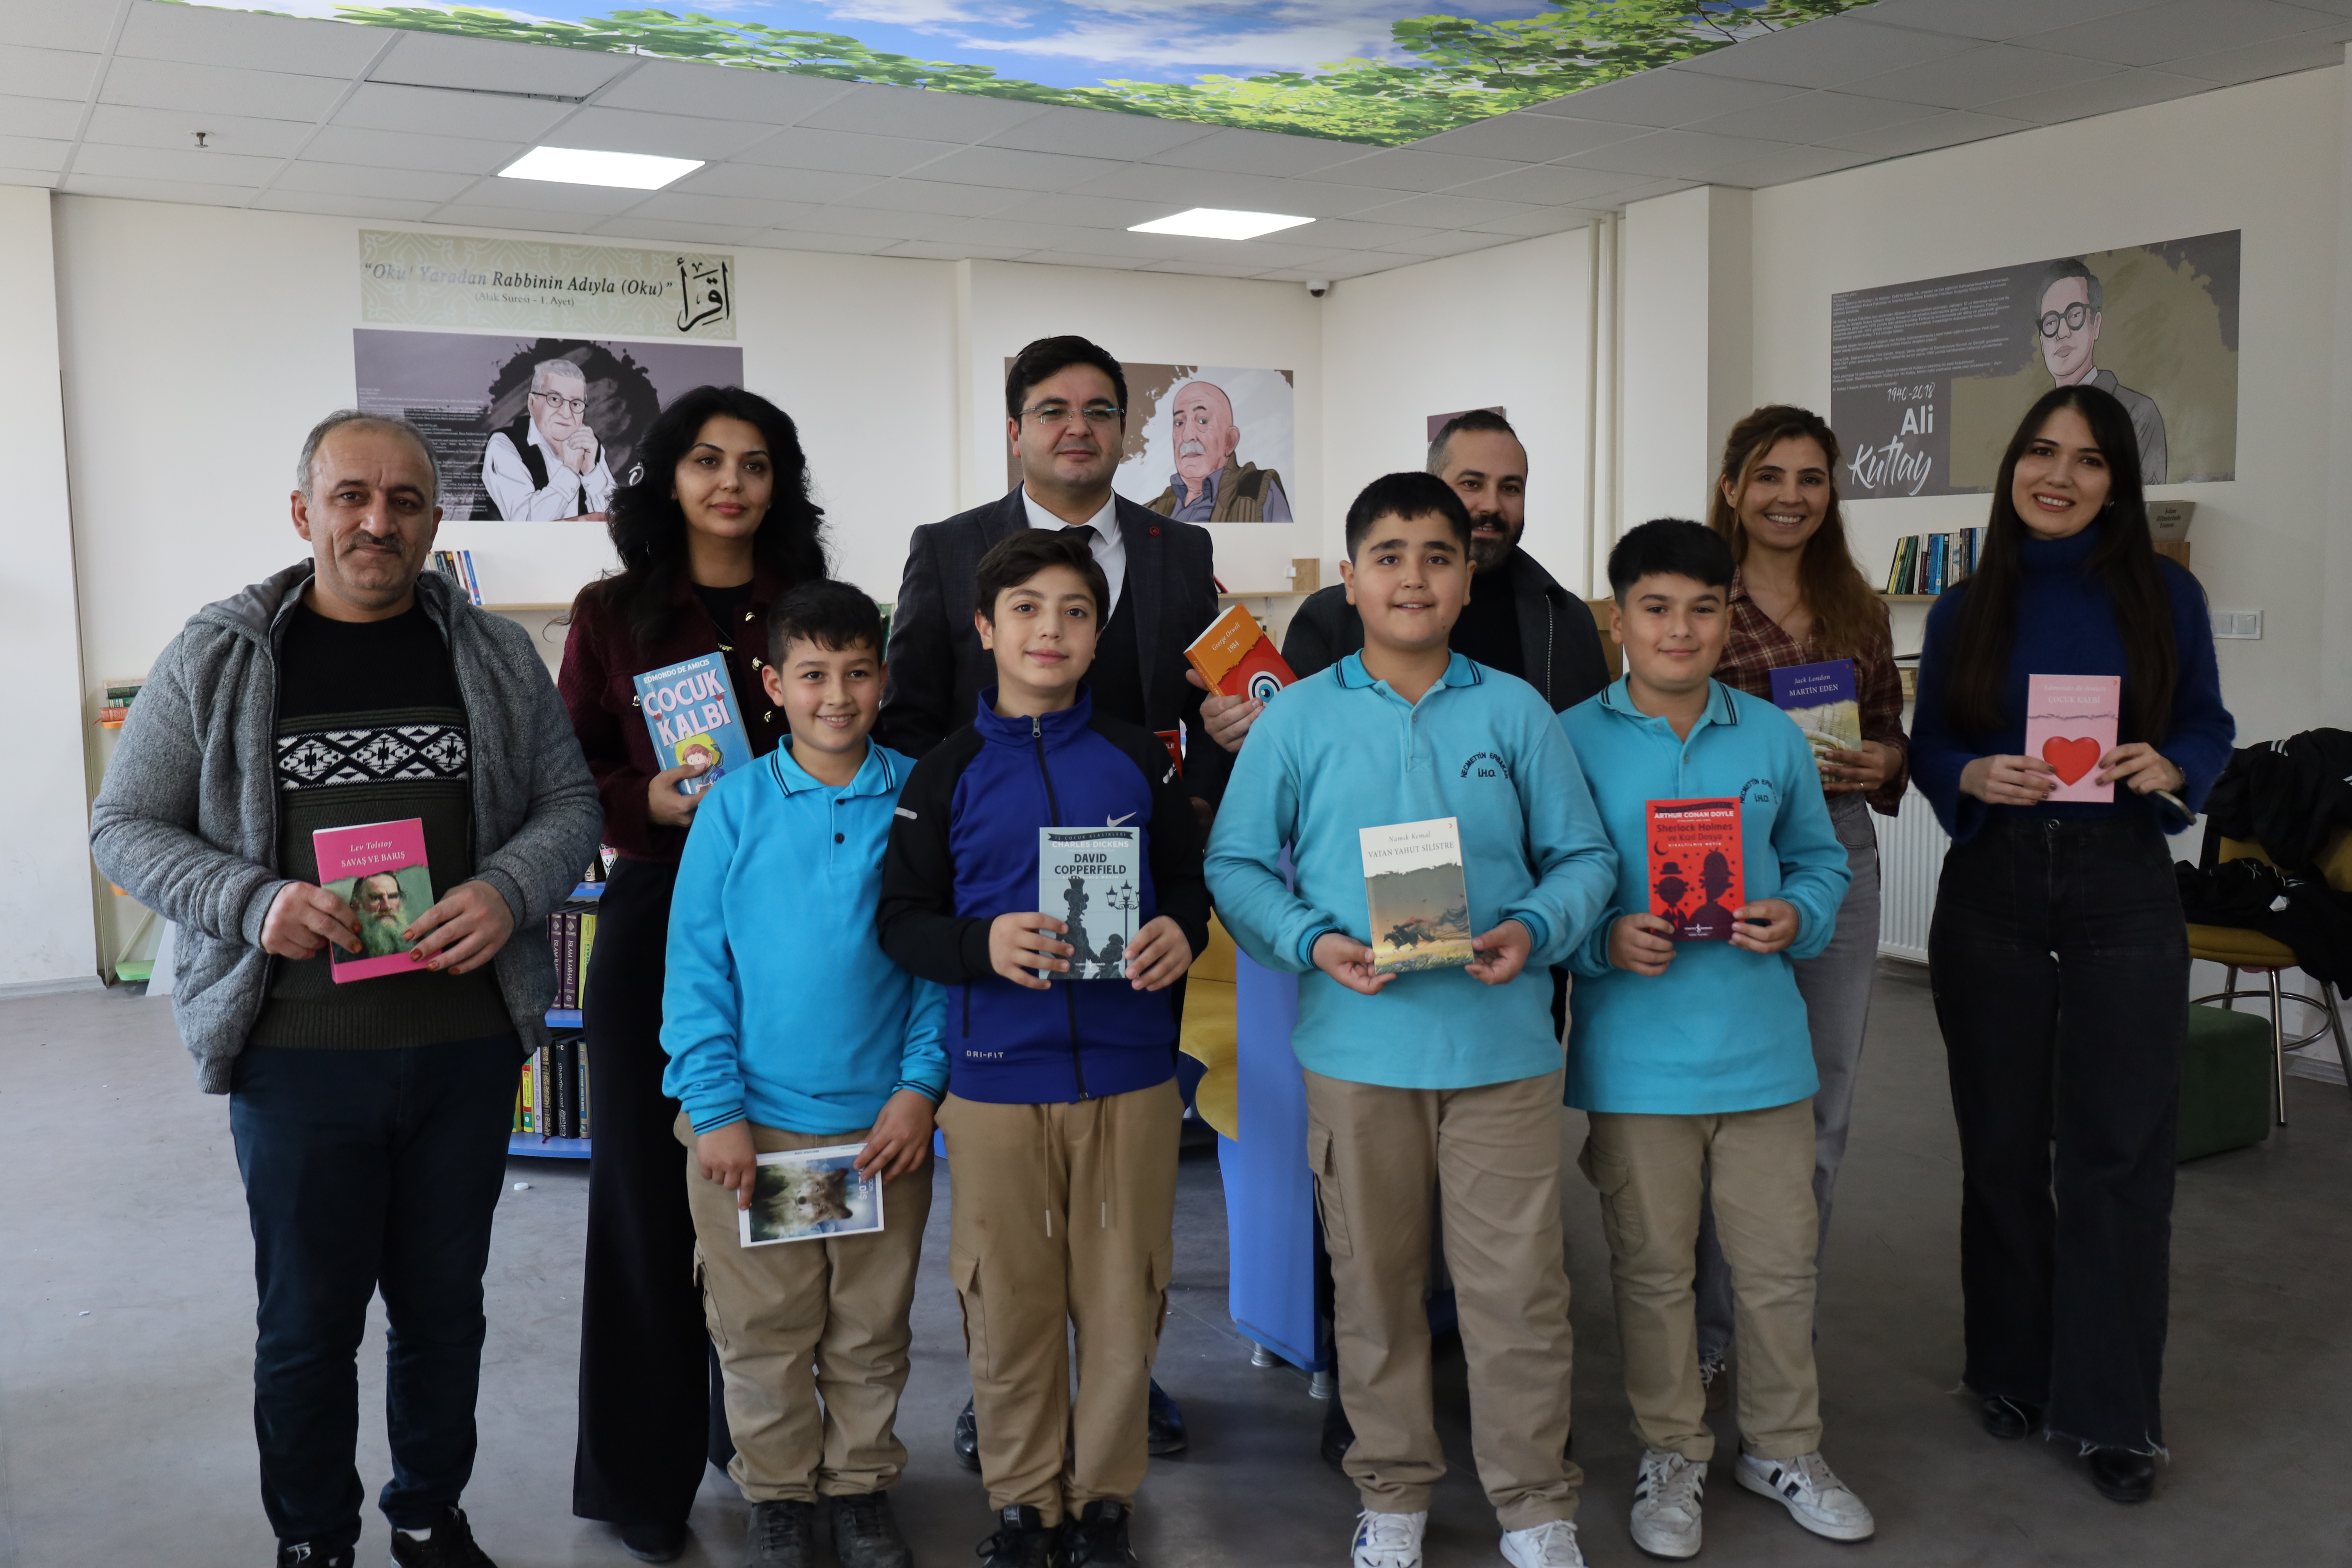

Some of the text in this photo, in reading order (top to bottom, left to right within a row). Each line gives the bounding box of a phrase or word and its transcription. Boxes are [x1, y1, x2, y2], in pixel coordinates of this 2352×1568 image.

[420, 266, 487, 285] Yaradan
[492, 271, 562, 290] Rabbinin
[567, 276, 614, 296] Adıyla
[502, 294, 529, 303] Suresi
[550, 297, 574, 307] Ayet)
[1887, 382, 1935, 402] 1940-2018
[1900, 404, 1933, 435] Ali
[1847, 435, 1932, 496] Kutlay
[1212, 622, 1240, 651] George Orwell
[1227, 640, 1240, 653] 1984
[643, 669, 677, 684] EDMONDO
[677, 666, 687, 674] DE
[643, 668, 727, 718] ÇOCUK
[1789, 684, 1839, 697] MARTİN EDEN
[1460, 752, 1508, 779] NECMETTİN ERBAKAN
[1657, 824, 1696, 832] Sherlock
[1389, 831, 1430, 842] Namık Kemal
[1698, 833, 1723, 841] Dosya
[366, 841, 392, 849] Tolstoy
[1368, 841, 1454, 858] VATAN YAHUT SİLİSTRE
[341, 851, 406, 867] SAVAŞ VE BARIŞ
[1074, 853, 1107, 863] DAVID
[1054, 865, 1126, 874] COPPERFIELD
[966, 1050, 1004, 1058] DRI-FIT
[858, 1185, 868, 1200] DİŞ
